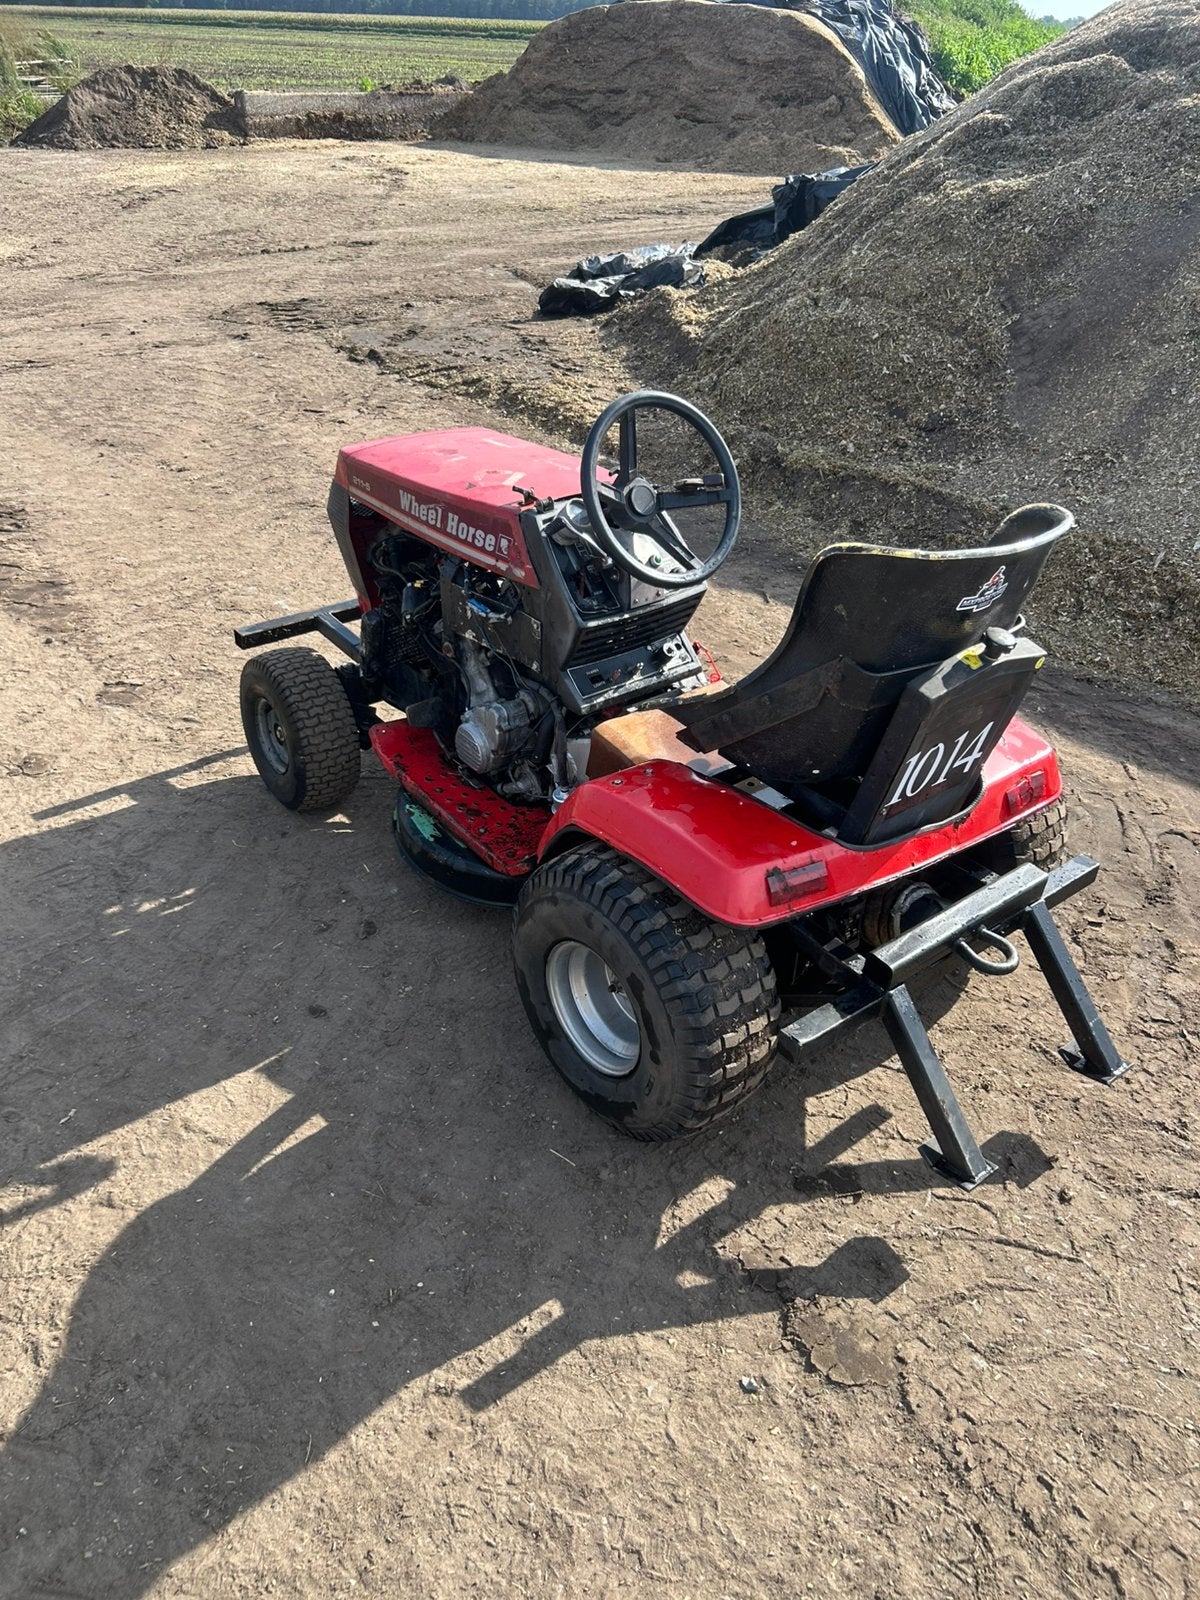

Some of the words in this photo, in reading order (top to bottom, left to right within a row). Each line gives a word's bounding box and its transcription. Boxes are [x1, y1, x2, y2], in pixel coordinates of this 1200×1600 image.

[399, 489, 442, 528] Wheel
[447, 512, 496, 552] Horse
[884, 721, 994, 808] 1014
